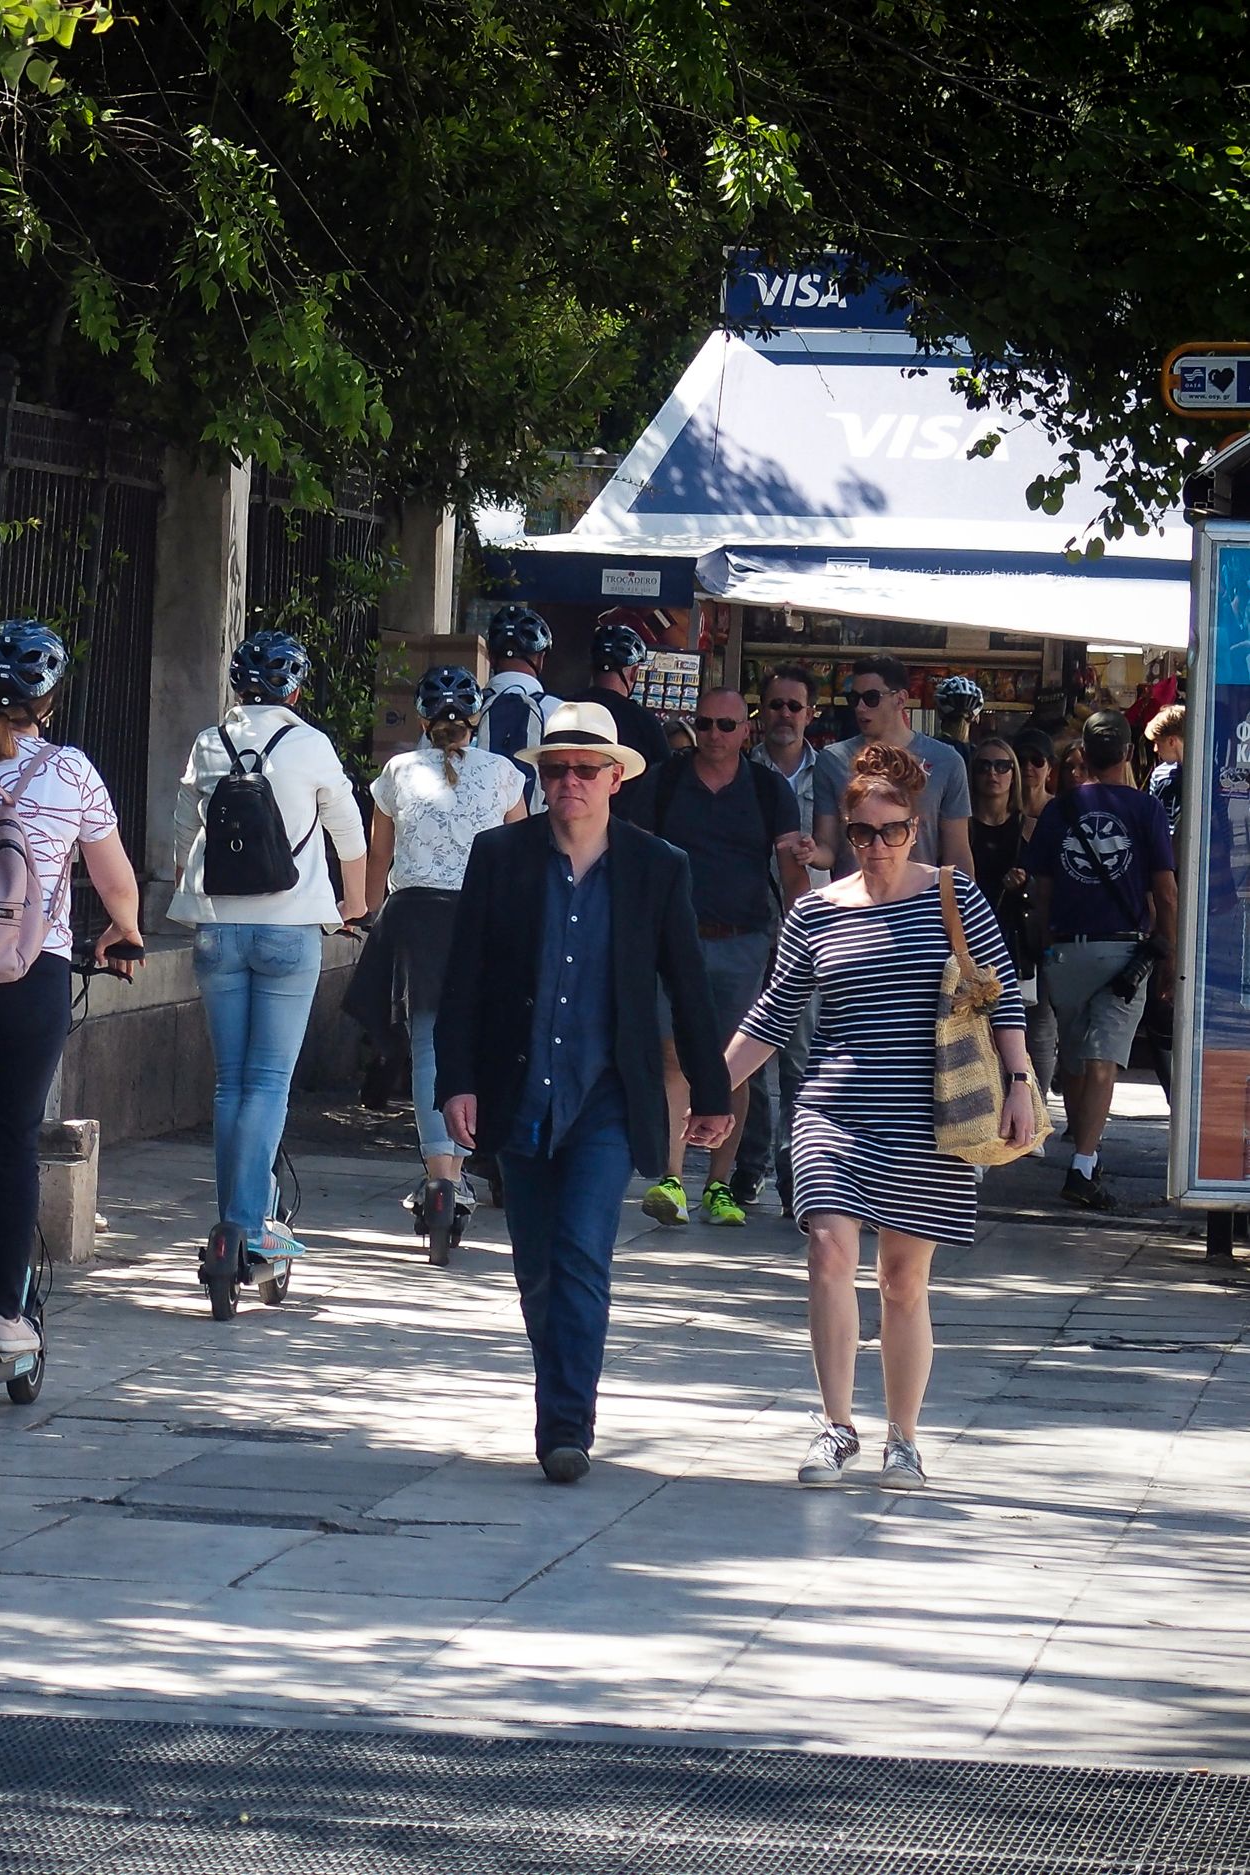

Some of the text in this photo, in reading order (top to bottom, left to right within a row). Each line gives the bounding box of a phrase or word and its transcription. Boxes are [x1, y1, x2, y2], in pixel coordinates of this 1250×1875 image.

[748, 272, 848, 308] VISA
[826, 412, 1010, 462] VISA
[605, 575, 658, 585] TROCADERO
